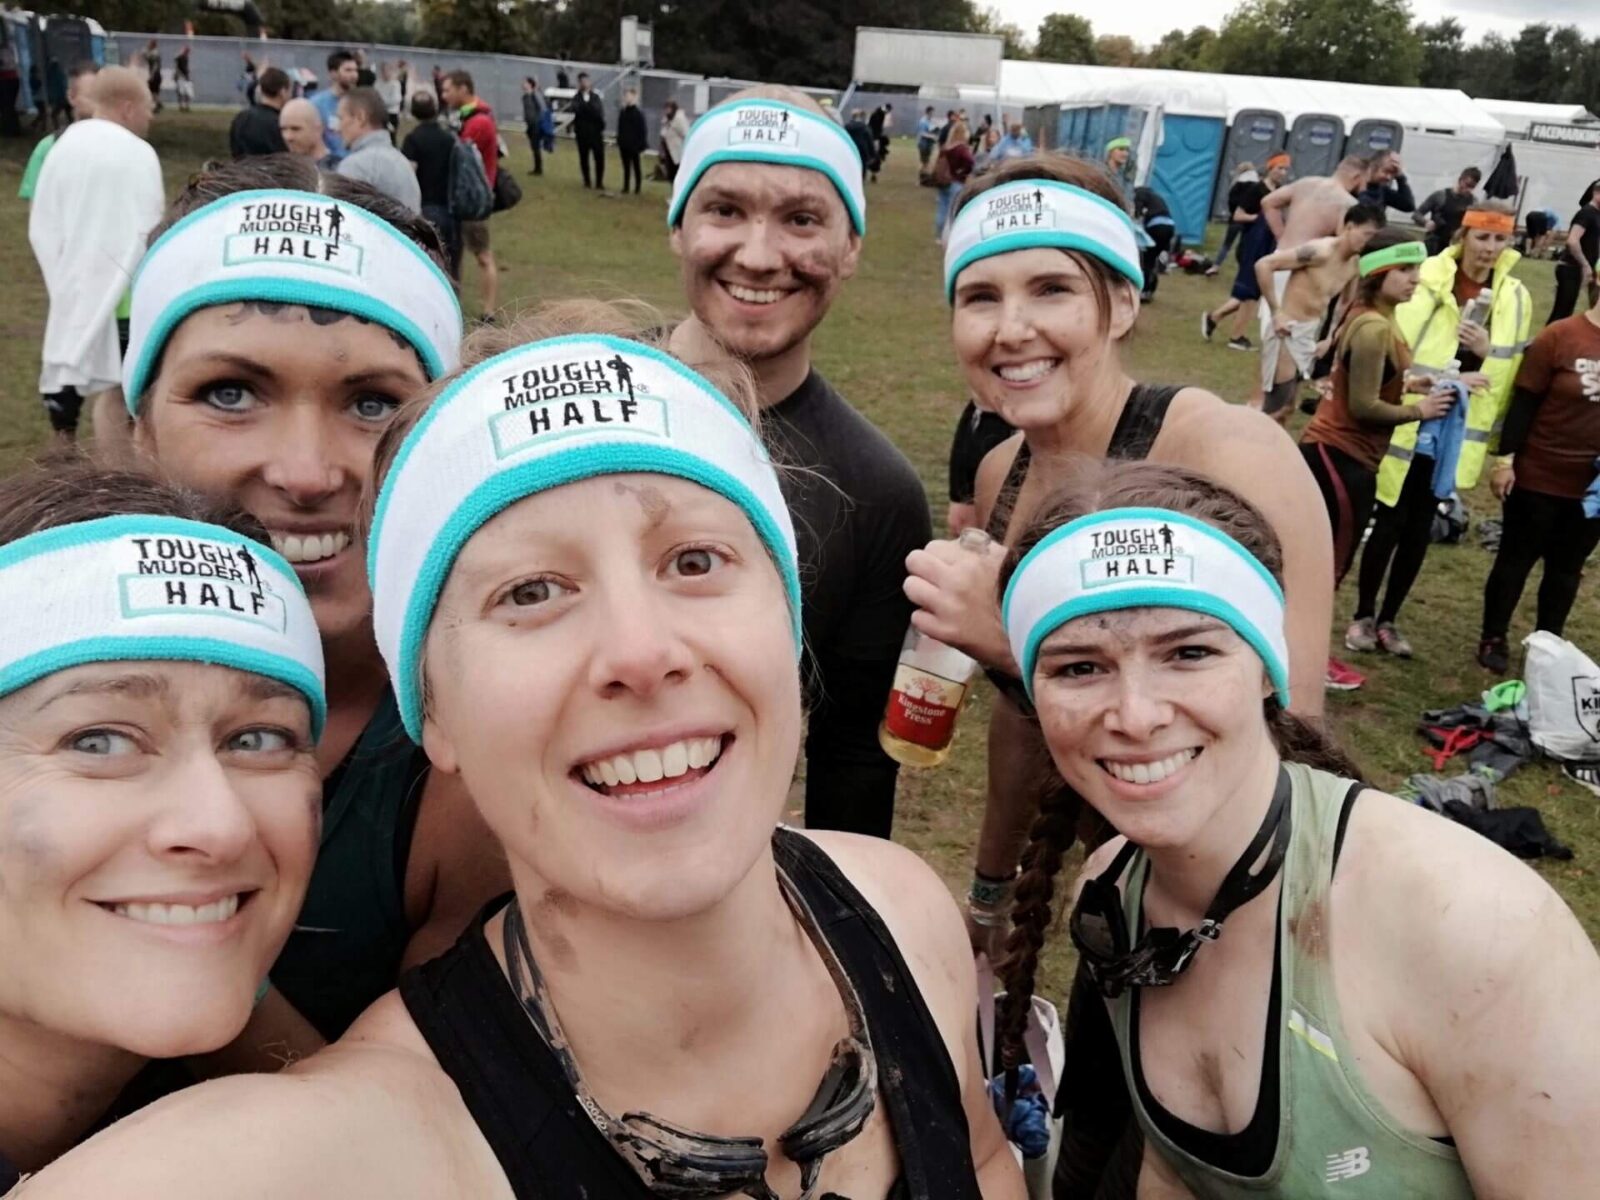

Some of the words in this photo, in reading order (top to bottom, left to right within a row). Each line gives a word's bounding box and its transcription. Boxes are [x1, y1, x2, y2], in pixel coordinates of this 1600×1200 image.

[737, 110, 778, 120] TOUGH
[743, 129, 787, 141] HALF
[988, 192, 1031, 210] TOUGH
[242, 203, 321, 224] TOUGH
[996, 213, 1042, 230] HALF
[240, 221, 322, 236] MUDDER
[254, 237, 339, 261] HALF
[502, 360, 605, 394] TOUGH
[504, 380, 613, 410] MUDDER
[529, 400, 638, 435] HALF
[1091, 528, 1156, 547] TOUGH
[131, 539, 239, 568] TOUGH
[1091, 544, 1160, 559] MUDDER
[138, 560, 244, 584] MUDDER
[1106, 559, 1175, 577] HALF
[165, 581, 265, 615] HALF
[898, 693, 946, 716] Kingstone
[904, 708, 932, 725] Press
